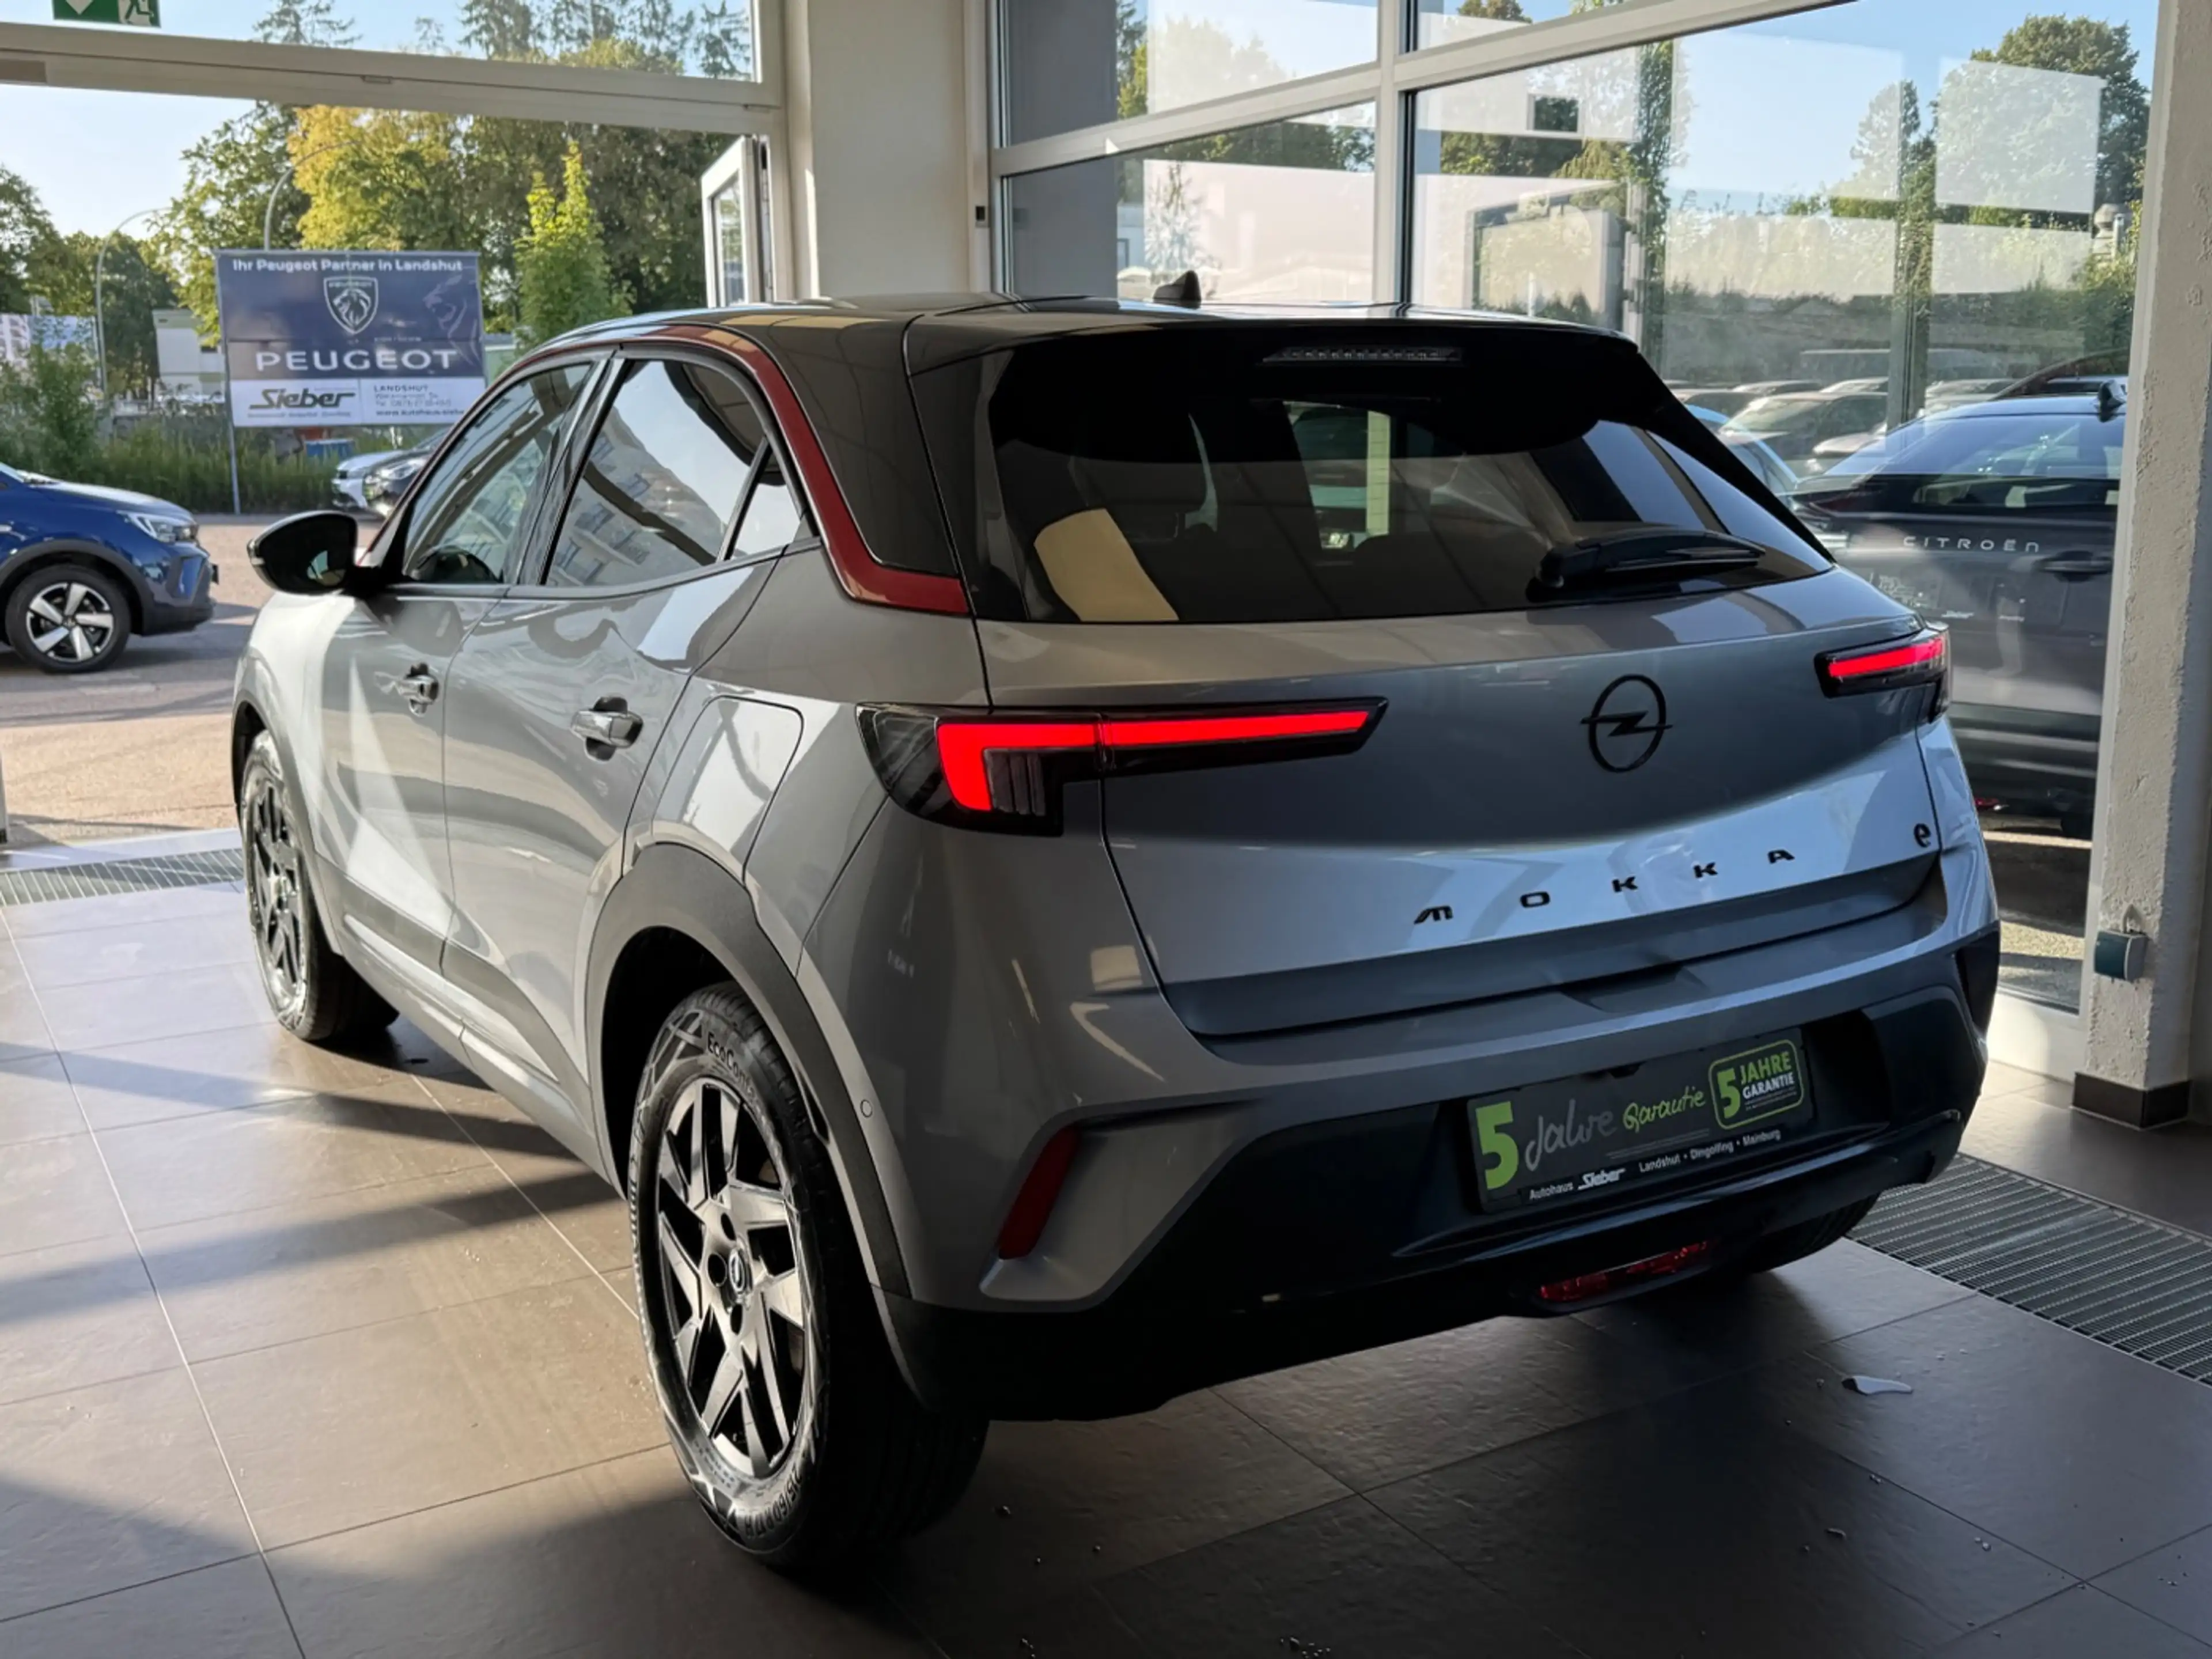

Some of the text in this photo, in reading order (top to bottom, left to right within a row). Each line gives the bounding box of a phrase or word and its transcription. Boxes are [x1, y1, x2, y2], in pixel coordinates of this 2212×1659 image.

[233, 259, 253, 272] Ihr
[256, 259, 318, 274] Peugeot
[321, 259, 375, 271] Partner
[395, 259, 463, 271] Landshut
[255, 349, 457, 372] PEUGEOT
[248, 388, 356, 410] Sieber
[1914, 823, 1931, 848] e
[1414, 849, 1796, 925] MOKKA
[1740, 1051, 1791, 1085] JAHRE
[1717, 1068, 1741, 1119] 5
[1742, 1071, 1796, 1099] GARANTIE
[1476, 1101, 1518, 1190] 5
[1622, 1086, 1706, 1133] Garantie
[1529, 1128, 1781, 1200] Autohaus Sieber Landshut Dingolfing Mainburg
